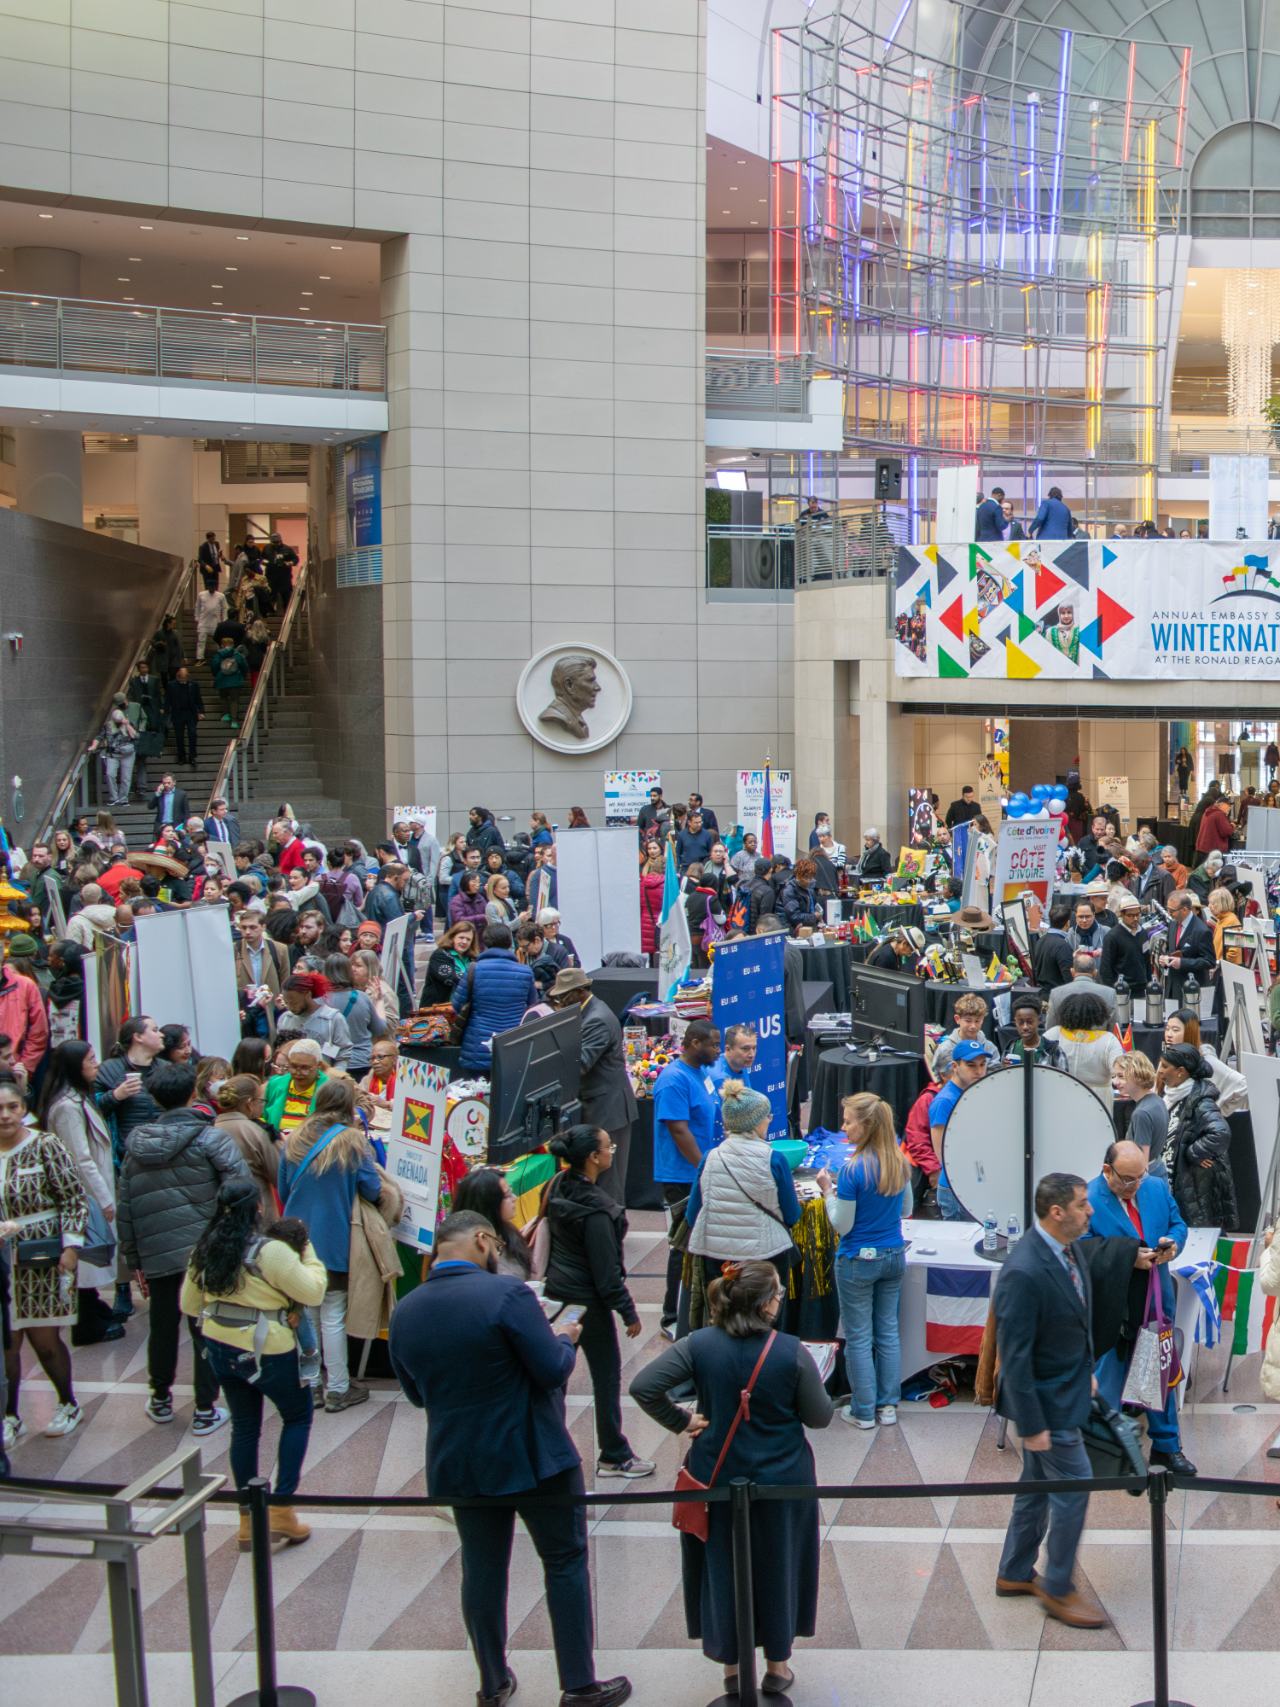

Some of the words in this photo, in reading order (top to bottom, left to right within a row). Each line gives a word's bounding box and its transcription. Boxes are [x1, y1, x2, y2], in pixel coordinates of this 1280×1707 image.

[1152, 611, 1204, 620] ANNUAL
[1211, 611, 1269, 620] EMBASSY
[1155, 656, 1167, 664] AT
[1172, 656, 1190, 664] THE
[1195, 656, 1240, 665] RONALD
[1011, 848, 1044, 870] CÔTE
[760, 1014, 781, 1038] US
[396, 1158, 428, 1186] GRENADA
